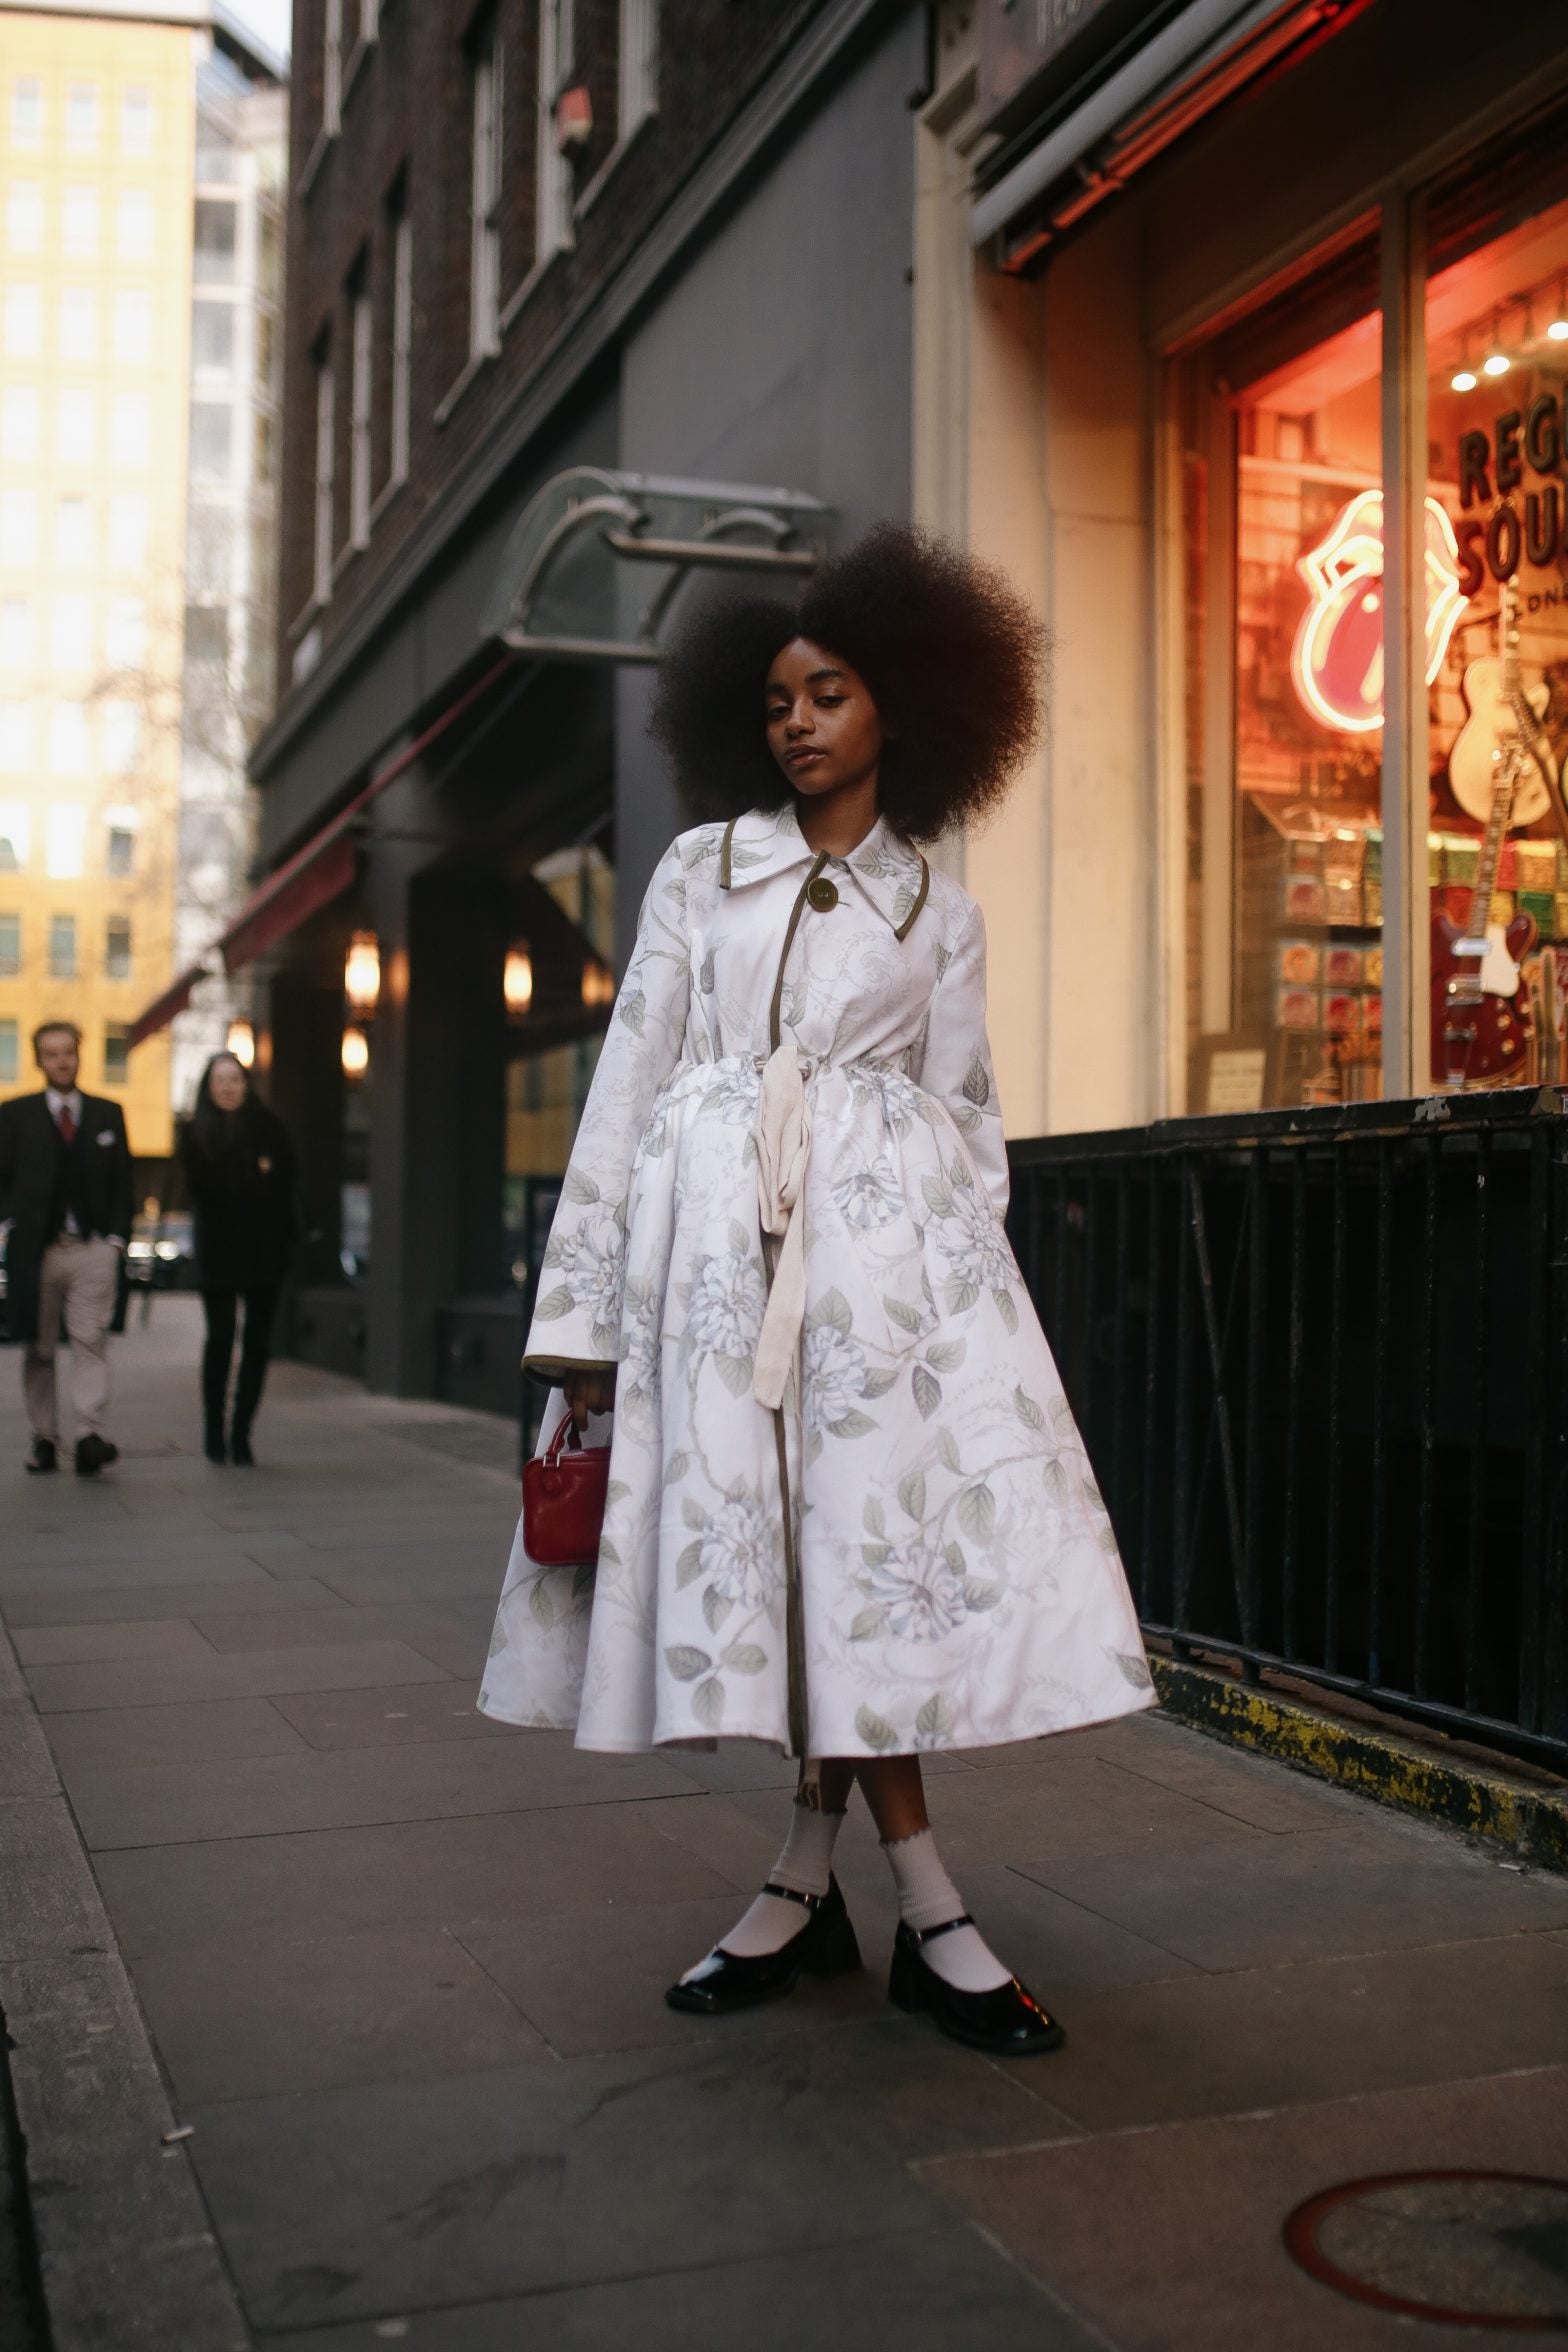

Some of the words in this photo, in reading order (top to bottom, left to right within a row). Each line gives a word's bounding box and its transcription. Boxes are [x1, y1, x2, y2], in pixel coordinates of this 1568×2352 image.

[1459, 385, 1567, 511] REG
[1456, 485, 1567, 599] SOU
[1512, 582, 1567, 620] LON
